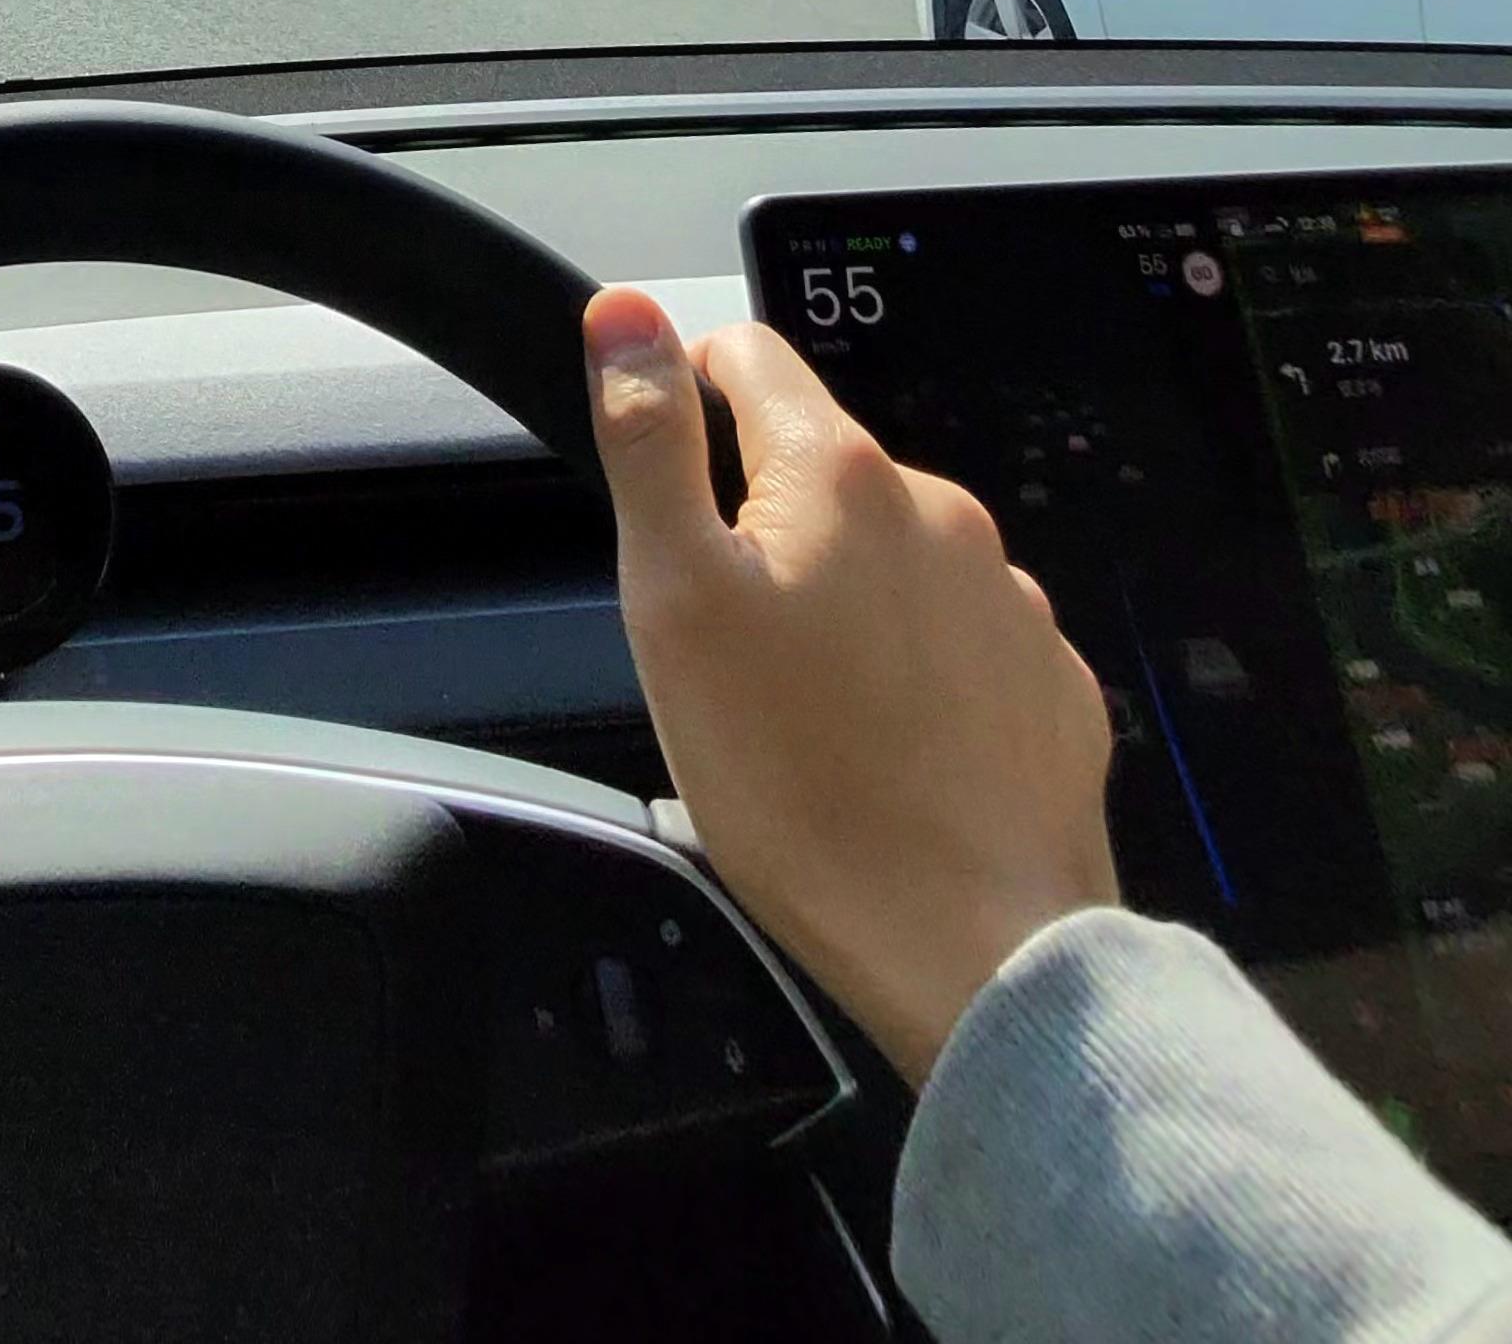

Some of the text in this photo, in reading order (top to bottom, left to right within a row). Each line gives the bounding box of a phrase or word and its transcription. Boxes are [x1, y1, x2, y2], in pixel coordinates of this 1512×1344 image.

[846, 235, 892, 252] READY
[802, 265, 885, 327] 55
[1326, 337, 1410, 365] 2.7 km
